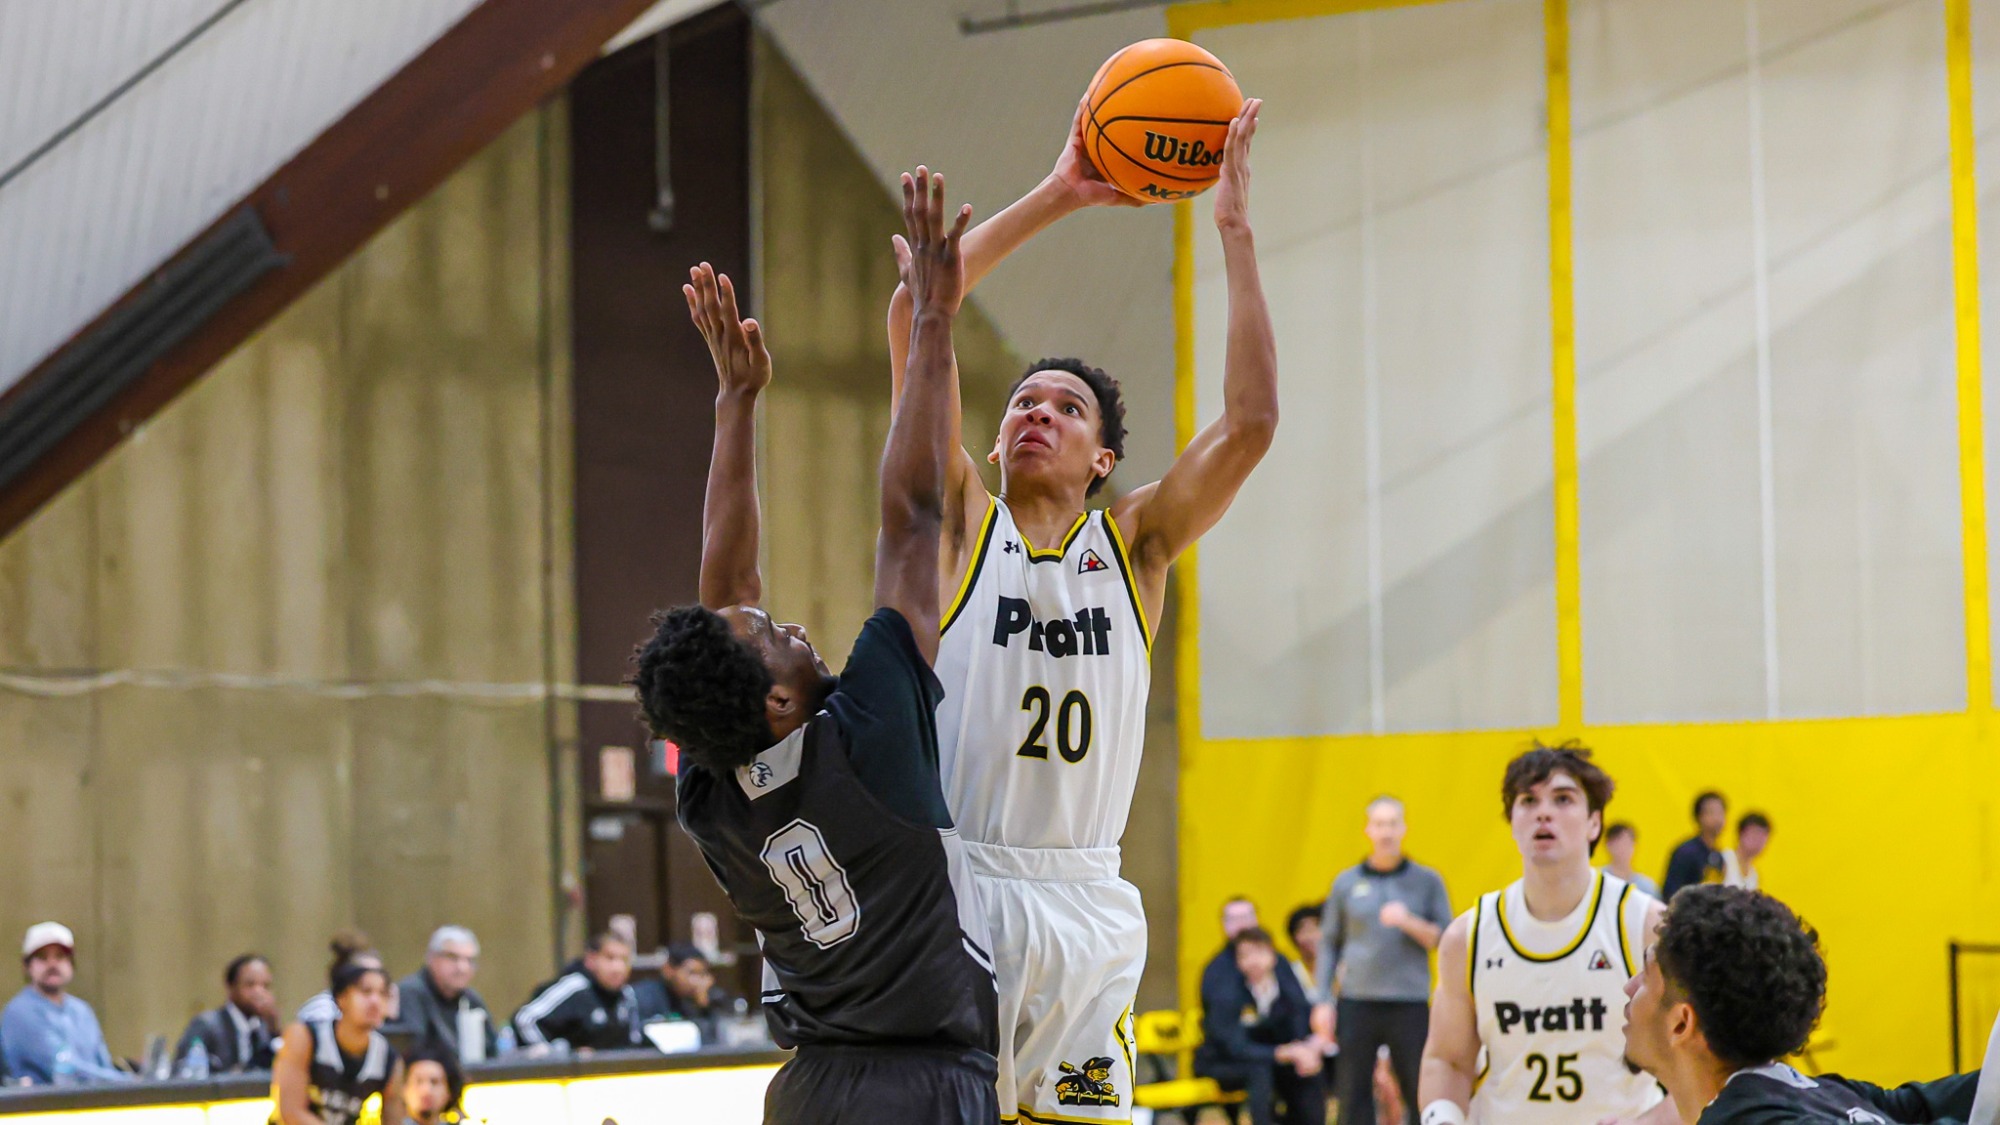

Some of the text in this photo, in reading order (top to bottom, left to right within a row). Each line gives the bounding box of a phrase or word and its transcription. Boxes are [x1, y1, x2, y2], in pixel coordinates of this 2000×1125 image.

[1144, 130, 1224, 166] Wilso
[992, 594, 1112, 658] Pratt
[1016, 684, 1092, 764] 20
[759, 817, 861, 950] 0
[1494, 996, 1608, 1034] Pratt
[1525, 1052, 1583, 1102] 25
